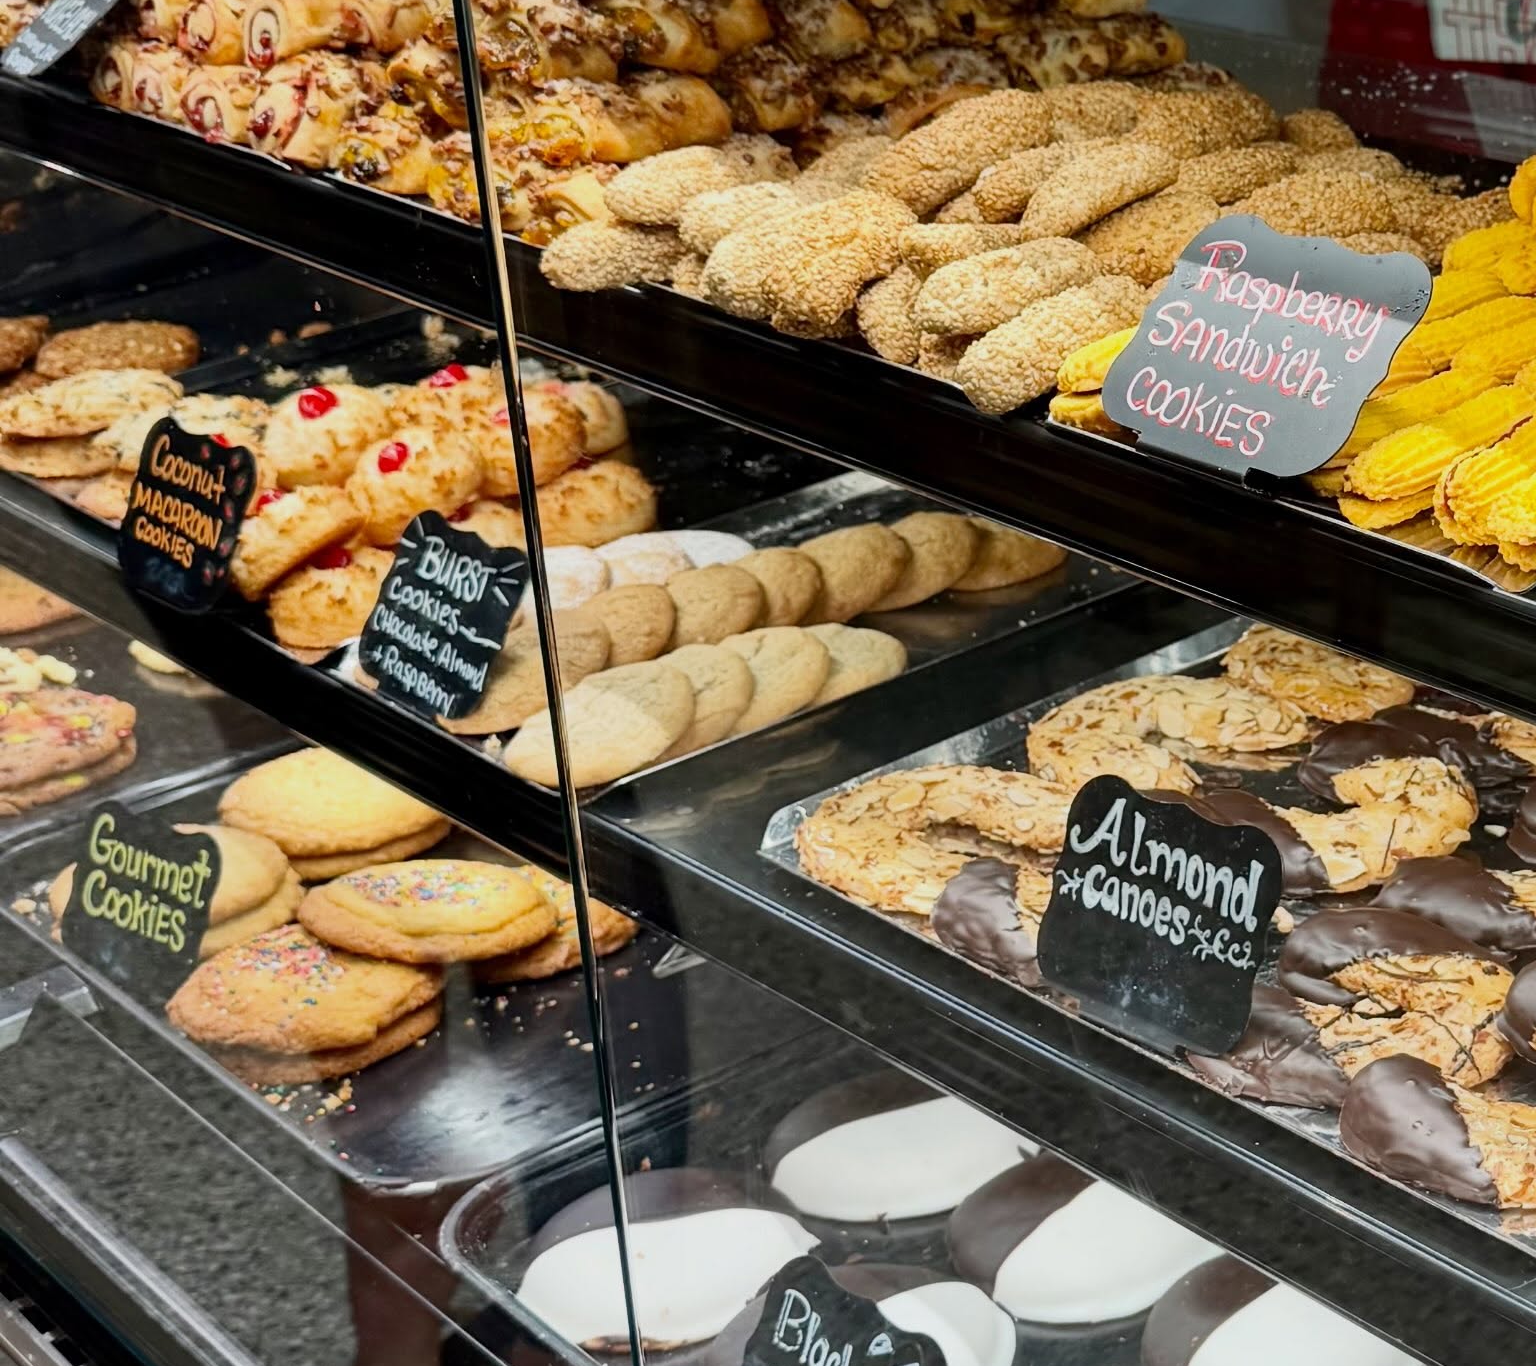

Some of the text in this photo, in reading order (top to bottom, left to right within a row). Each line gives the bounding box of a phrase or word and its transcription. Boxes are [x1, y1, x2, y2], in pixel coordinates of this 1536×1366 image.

[151, 435, 225, 505] Coconut
[132, 482, 223, 551] MACAROON
[416, 536, 498, 602] BURST
[89, 813, 212, 909] Gourmet
[1070, 798, 1264, 932] Almond
